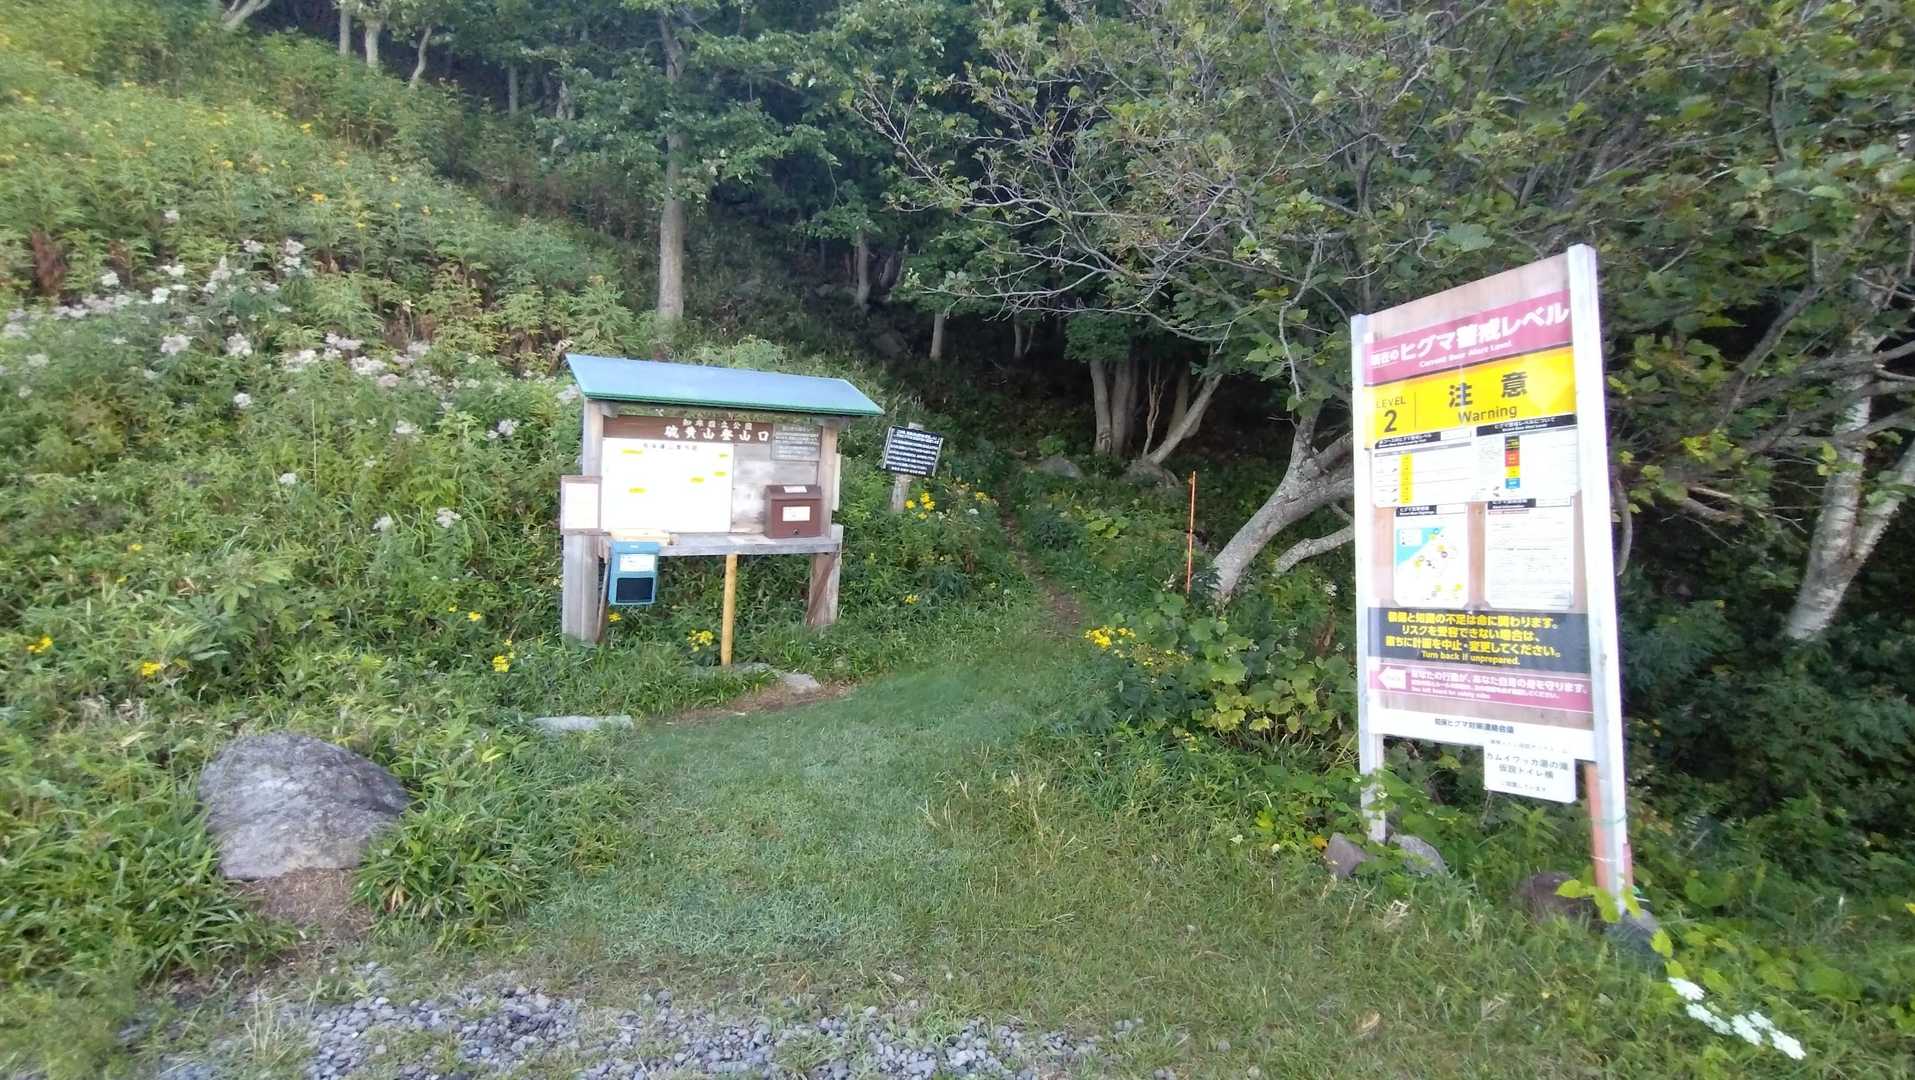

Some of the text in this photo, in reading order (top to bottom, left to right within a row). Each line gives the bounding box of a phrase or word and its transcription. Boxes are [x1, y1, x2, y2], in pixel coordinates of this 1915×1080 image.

[1448, 371, 1528, 409] 注意
[1376, 395, 1406, 409] LEVEL
[1384, 410, 1398, 433] 2
[1458, 406, 1518, 424] Warning
[664, 425, 770, 442] 硫黄山登山口
[1421, 650, 1439, 659] Turn
[1440, 651, 1460, 660] back
[1470, 655, 1521, 666] unprepared.
